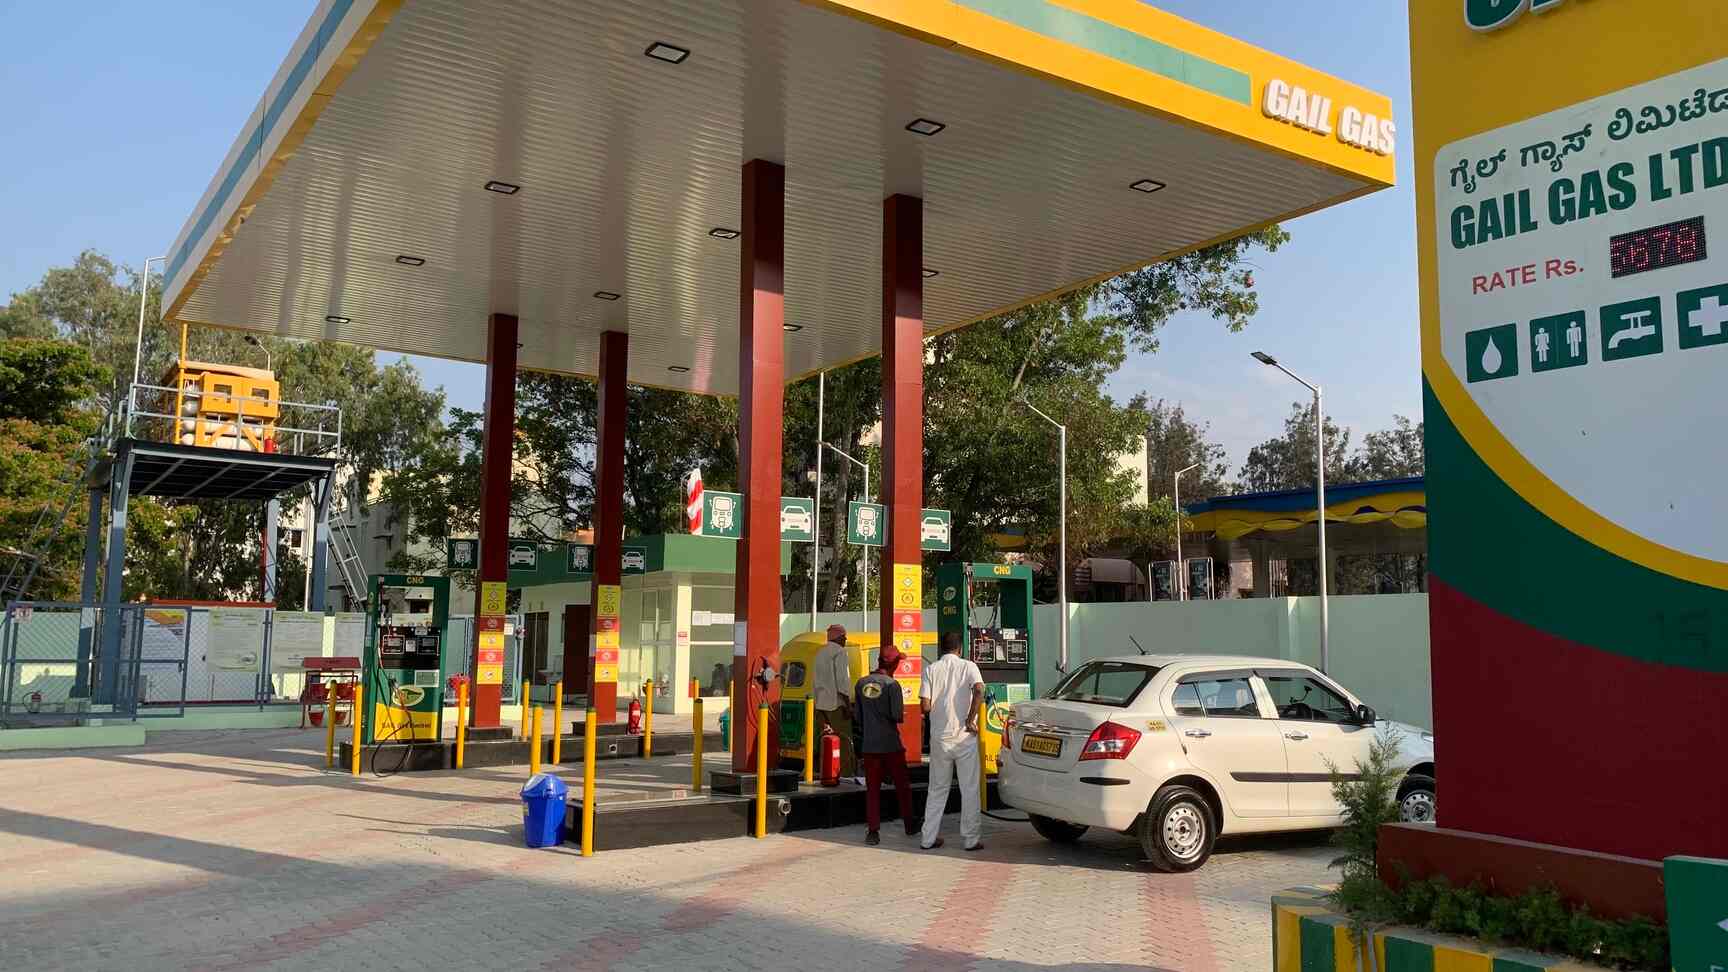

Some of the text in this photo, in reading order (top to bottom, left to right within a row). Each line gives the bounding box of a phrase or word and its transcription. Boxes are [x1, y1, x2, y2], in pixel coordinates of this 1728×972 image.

[1263, 79, 1396, 156] GAIL GAS
[1520, 123, 1592, 172] ಗ್ಯಾಸ್
[1450, 188, 1538, 250] GAIL
[1548, 162, 1637, 226] GAS
[1472, 259, 1584, 295] RATE Rs.
[406, 576, 425, 585] CNG
